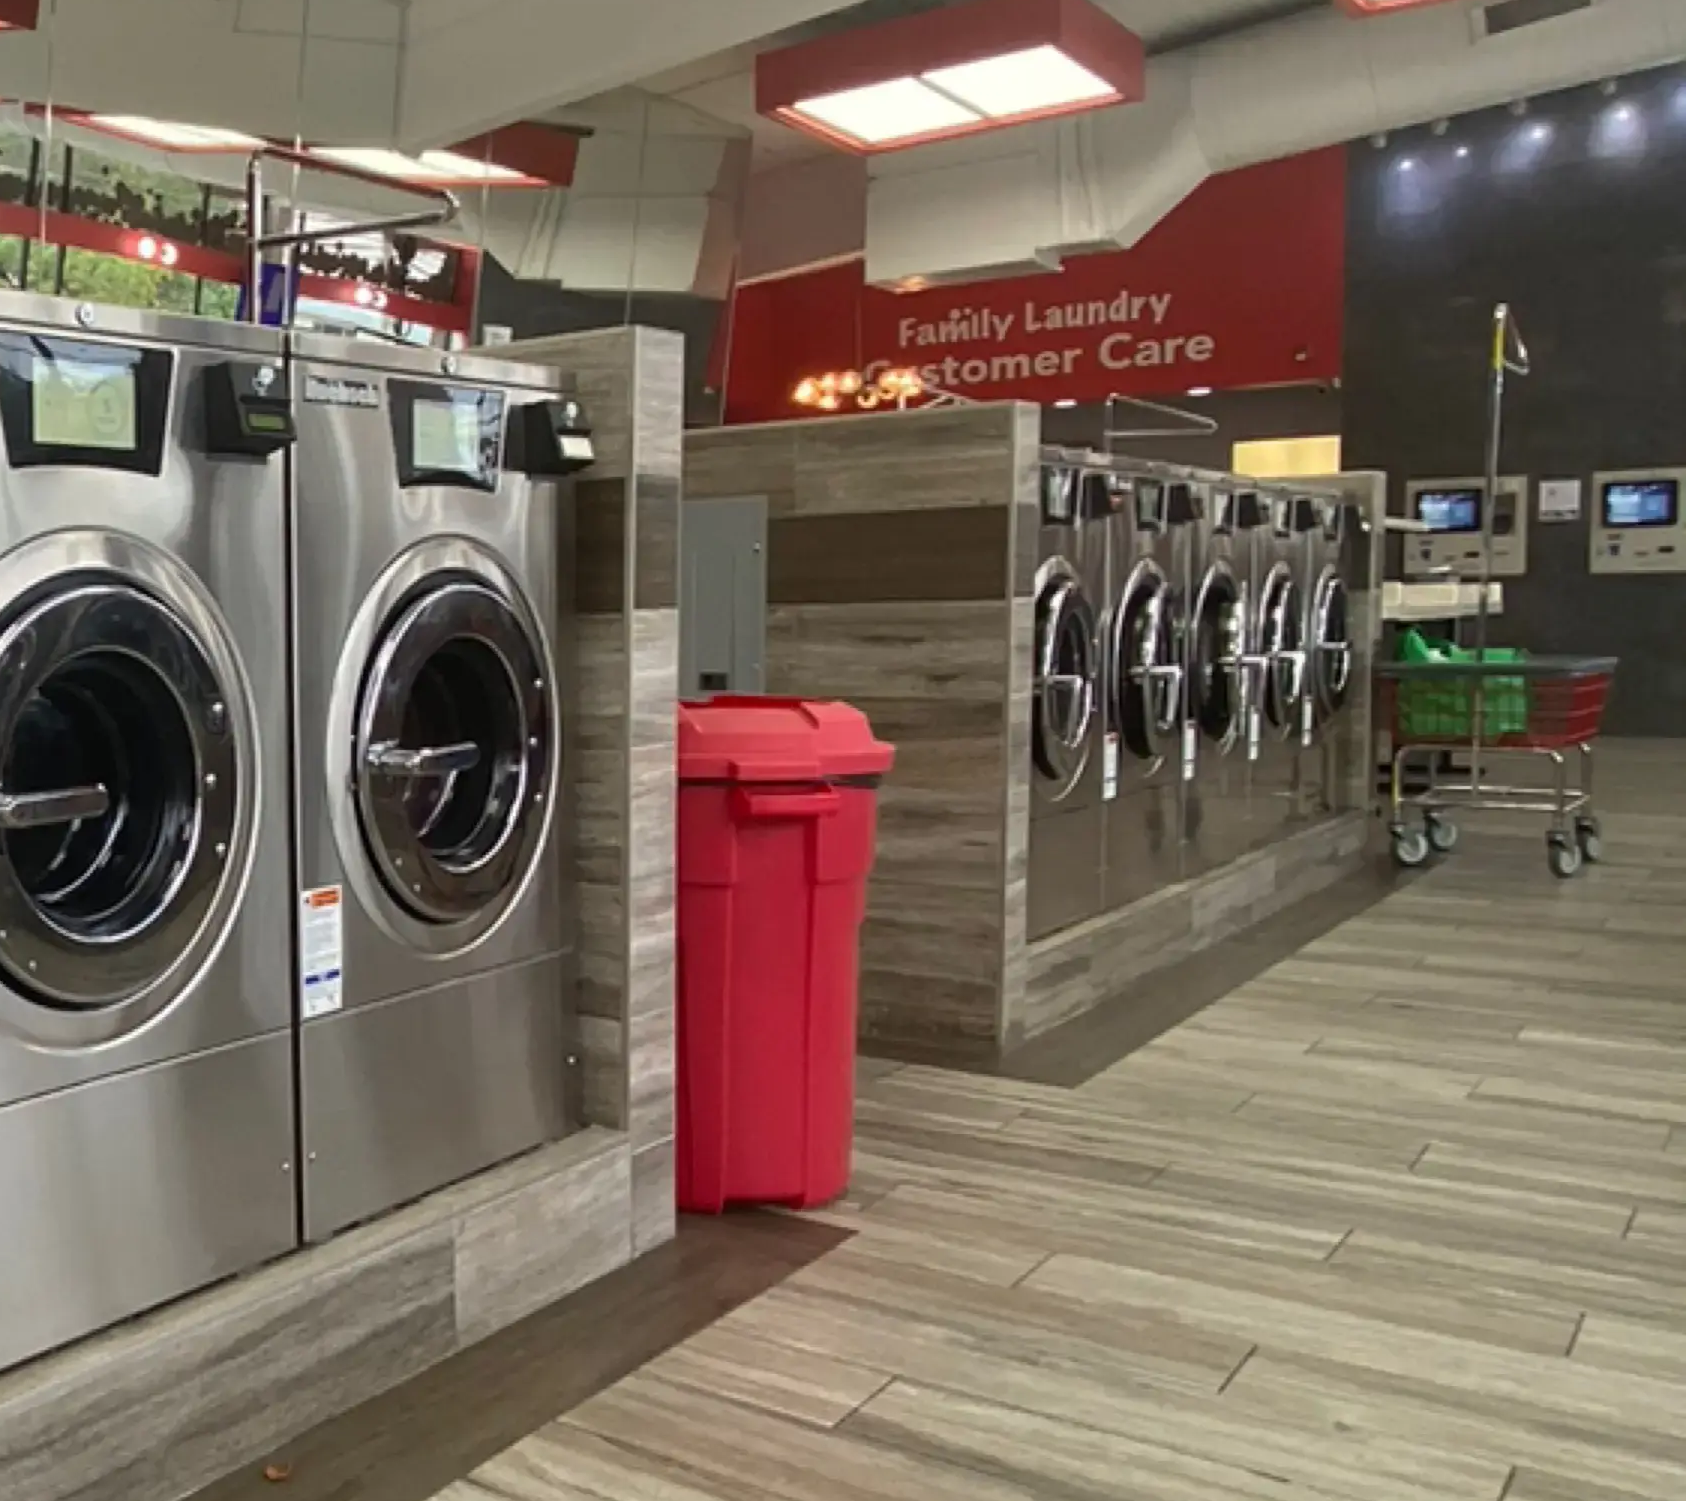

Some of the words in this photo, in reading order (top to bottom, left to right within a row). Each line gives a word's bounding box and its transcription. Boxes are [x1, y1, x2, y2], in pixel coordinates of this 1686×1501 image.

[898, 308, 1015, 349] Family
[1024, 290, 1172, 332] Laundry
[1098, 331, 1215, 370] Care
